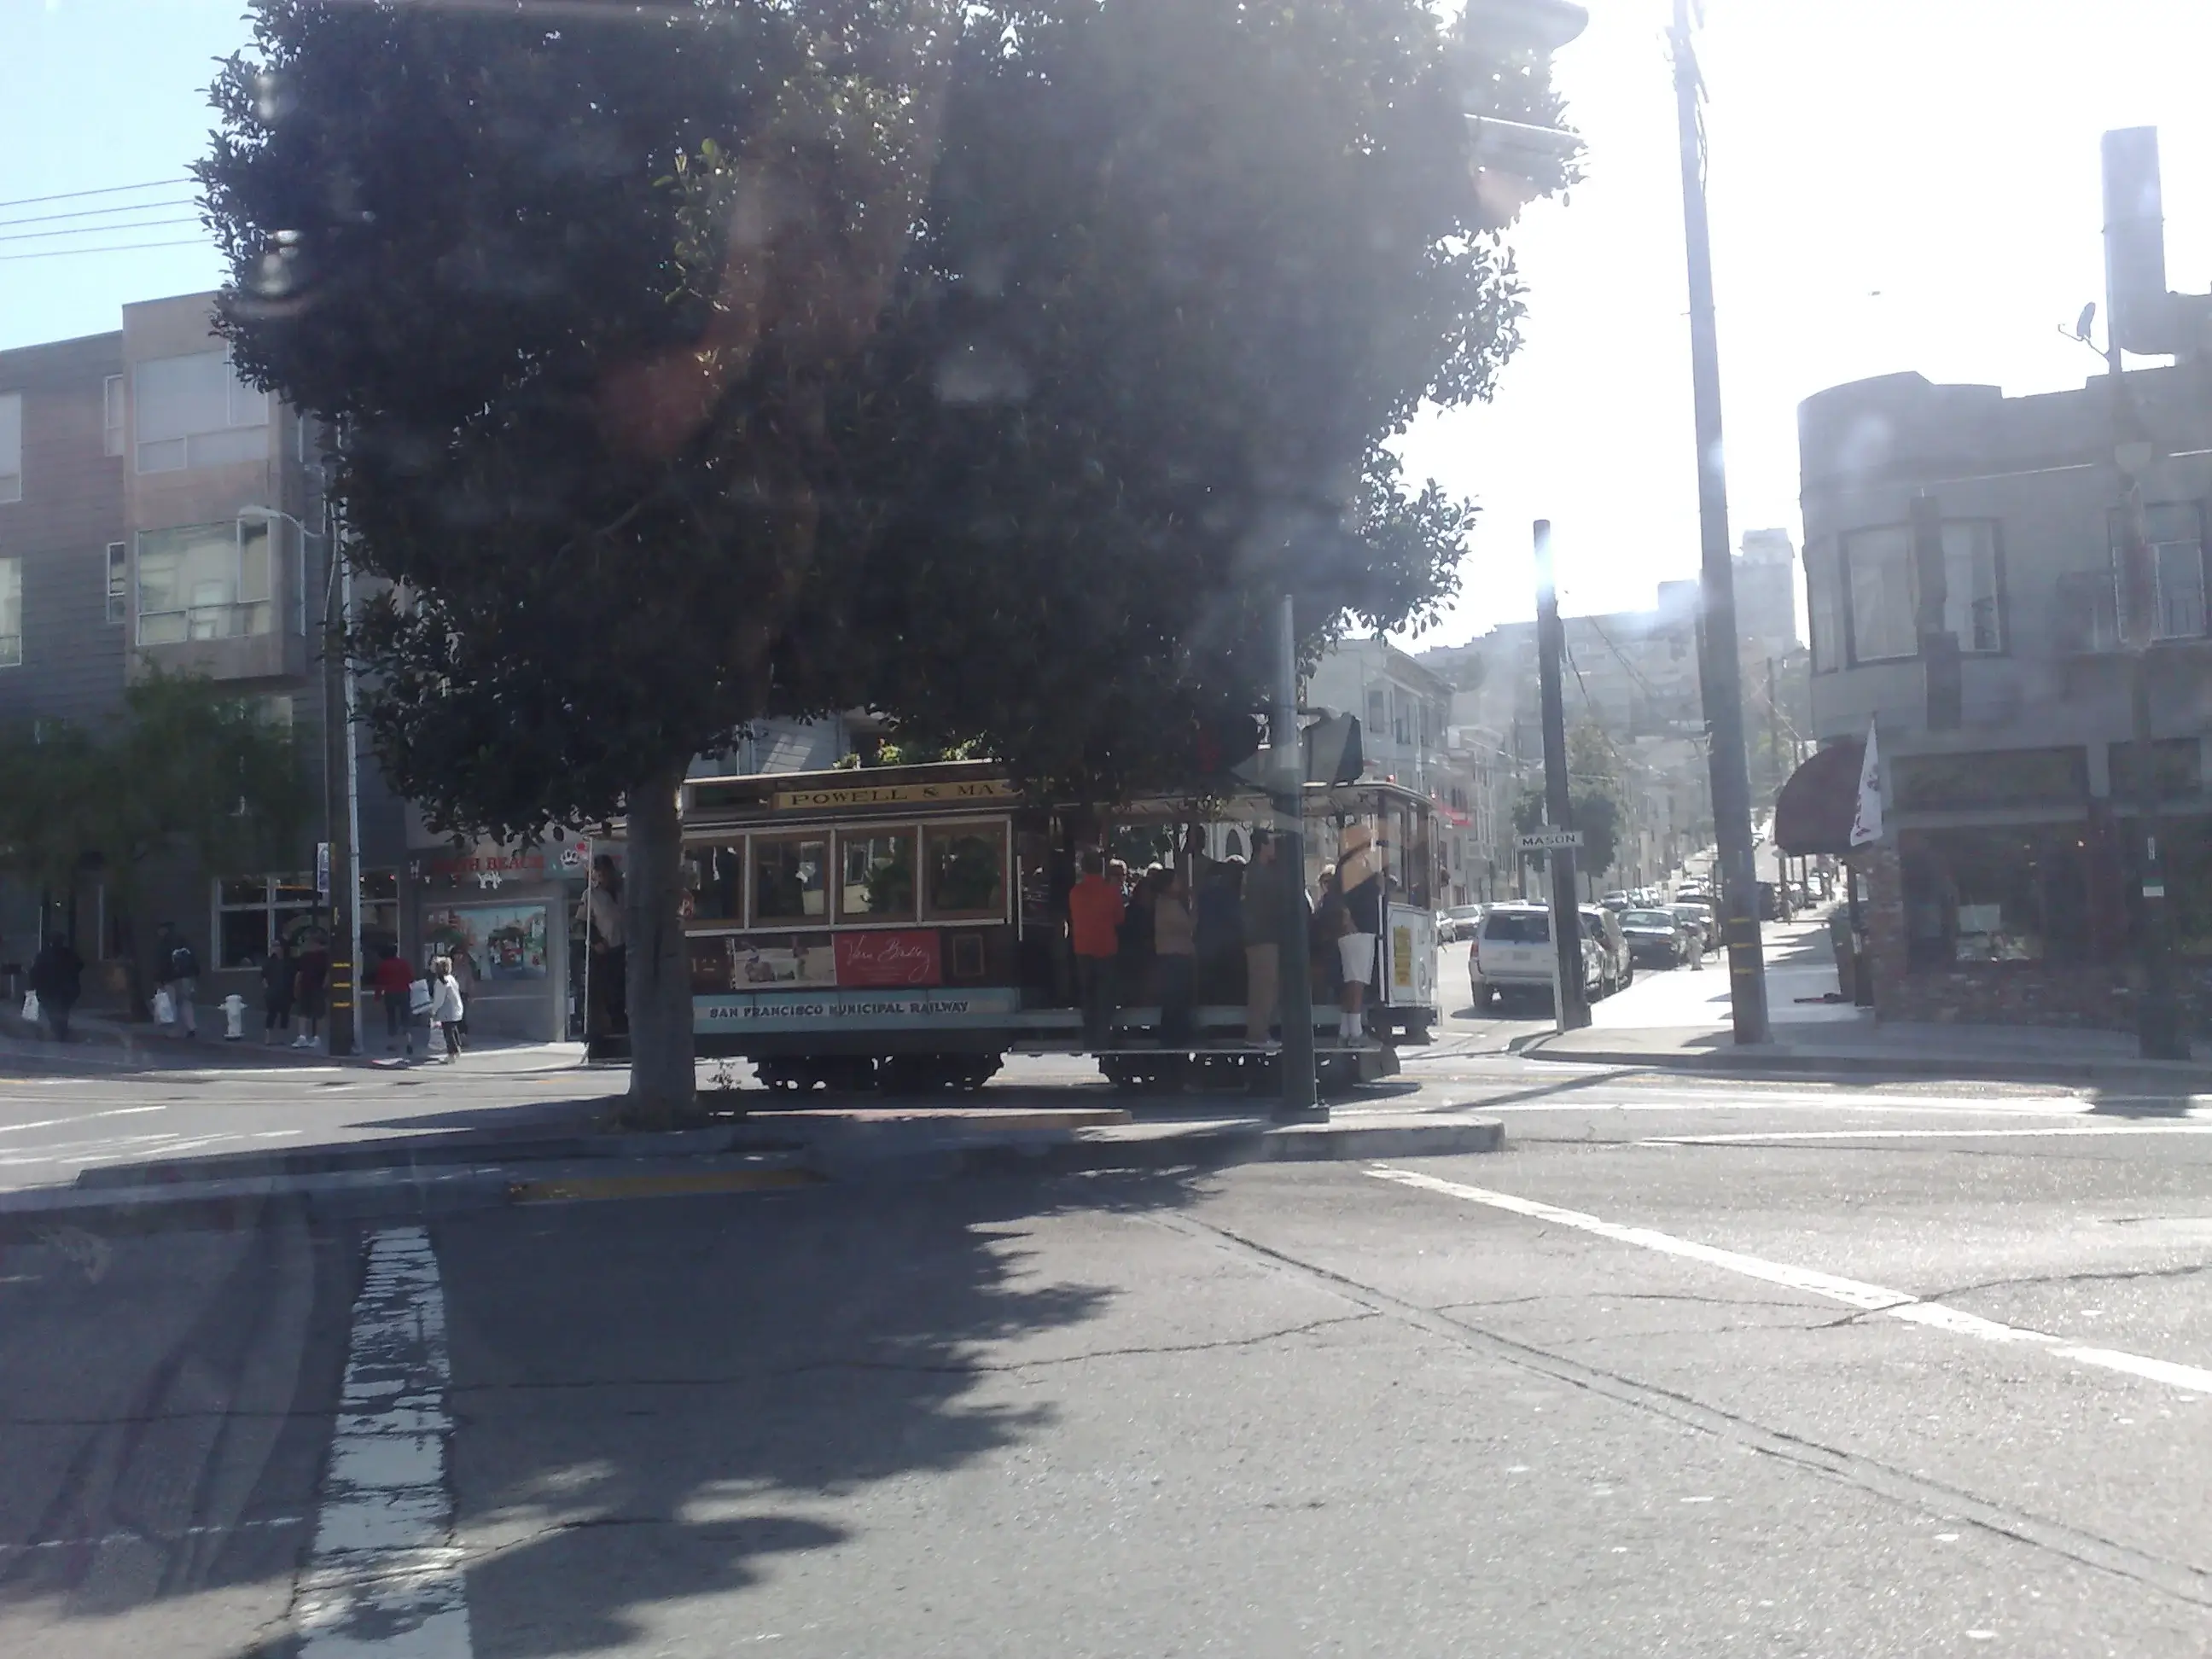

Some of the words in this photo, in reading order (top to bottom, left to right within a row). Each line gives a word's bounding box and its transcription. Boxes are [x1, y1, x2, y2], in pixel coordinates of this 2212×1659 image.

[791, 789, 908, 805] POWELL
[923, 786, 938, 798] &
[1522, 835, 1575, 847] MASON
[709, 1006, 738, 1018] SAN
[743, 1004, 824, 1018] FRANCISCO
[829, 1001, 905, 1016] MUNICIPAL
[910, 1000, 969, 1014] RAILWAY
